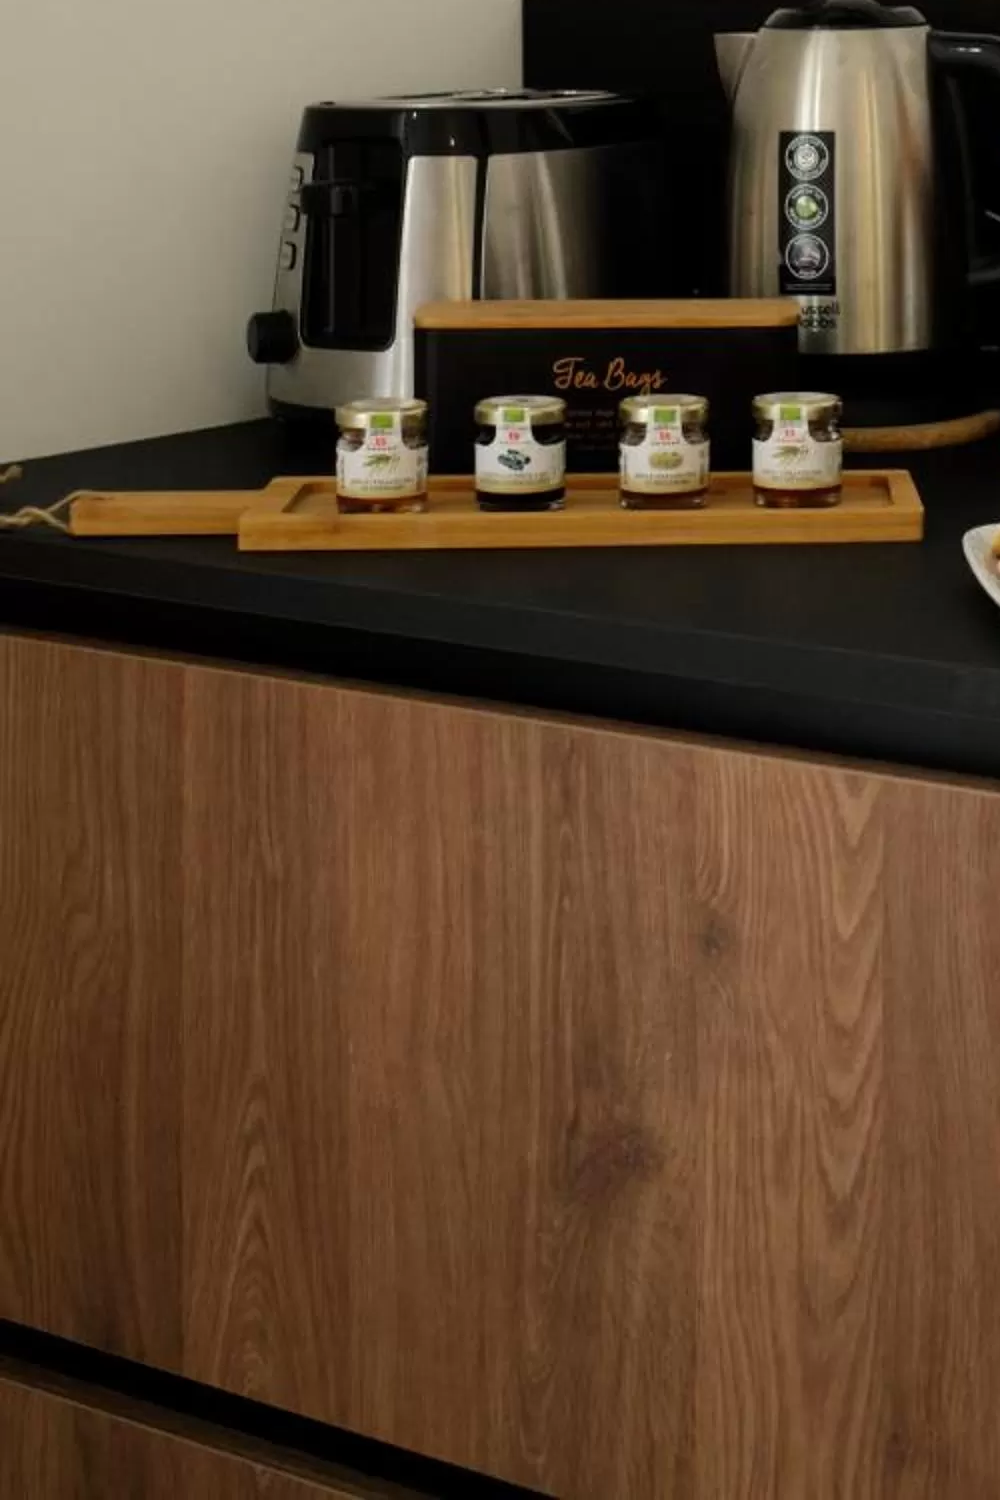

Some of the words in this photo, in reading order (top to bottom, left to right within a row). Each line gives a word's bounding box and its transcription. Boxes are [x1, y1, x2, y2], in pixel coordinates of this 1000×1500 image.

[801, 301, 841, 315] ussell
[552, 357, 598, 389] Tea
[603, 356, 668, 396] Bags
